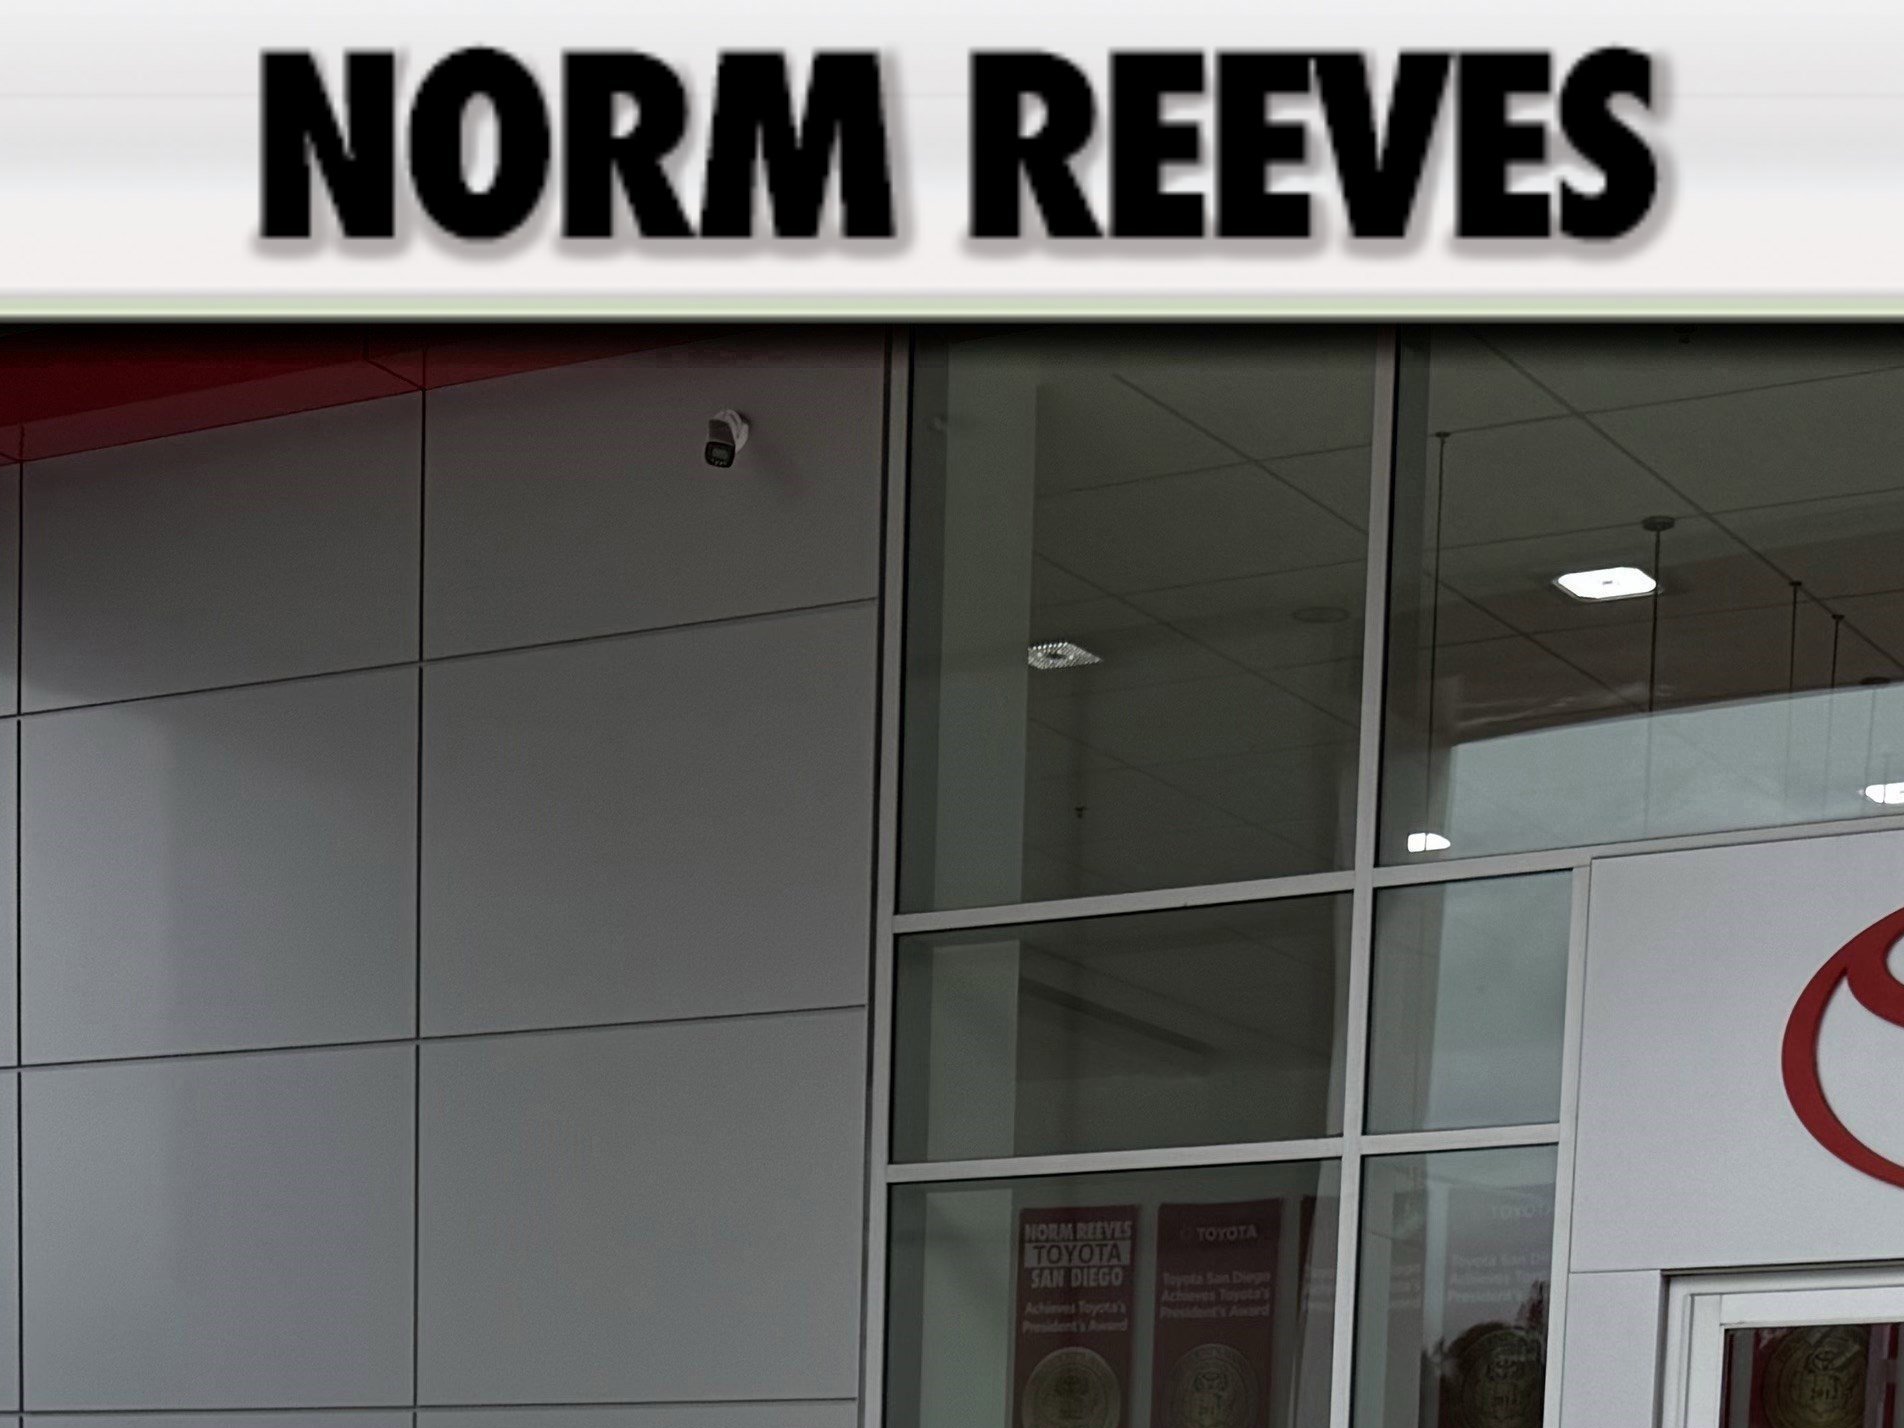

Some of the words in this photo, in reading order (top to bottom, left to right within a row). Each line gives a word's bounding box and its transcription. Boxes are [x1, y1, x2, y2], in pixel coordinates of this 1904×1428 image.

[1024, 1222, 1075, 1241] NORM
[1077, 1220, 1132, 1240] REEVES
[1196, 1224, 1258, 1242] TOYOTA
[1033, 1243, 1122, 1265] TOYOTA
[1031, 1269, 1064, 1288] SAN
[1071, 1267, 1124, 1287] DIEGO
